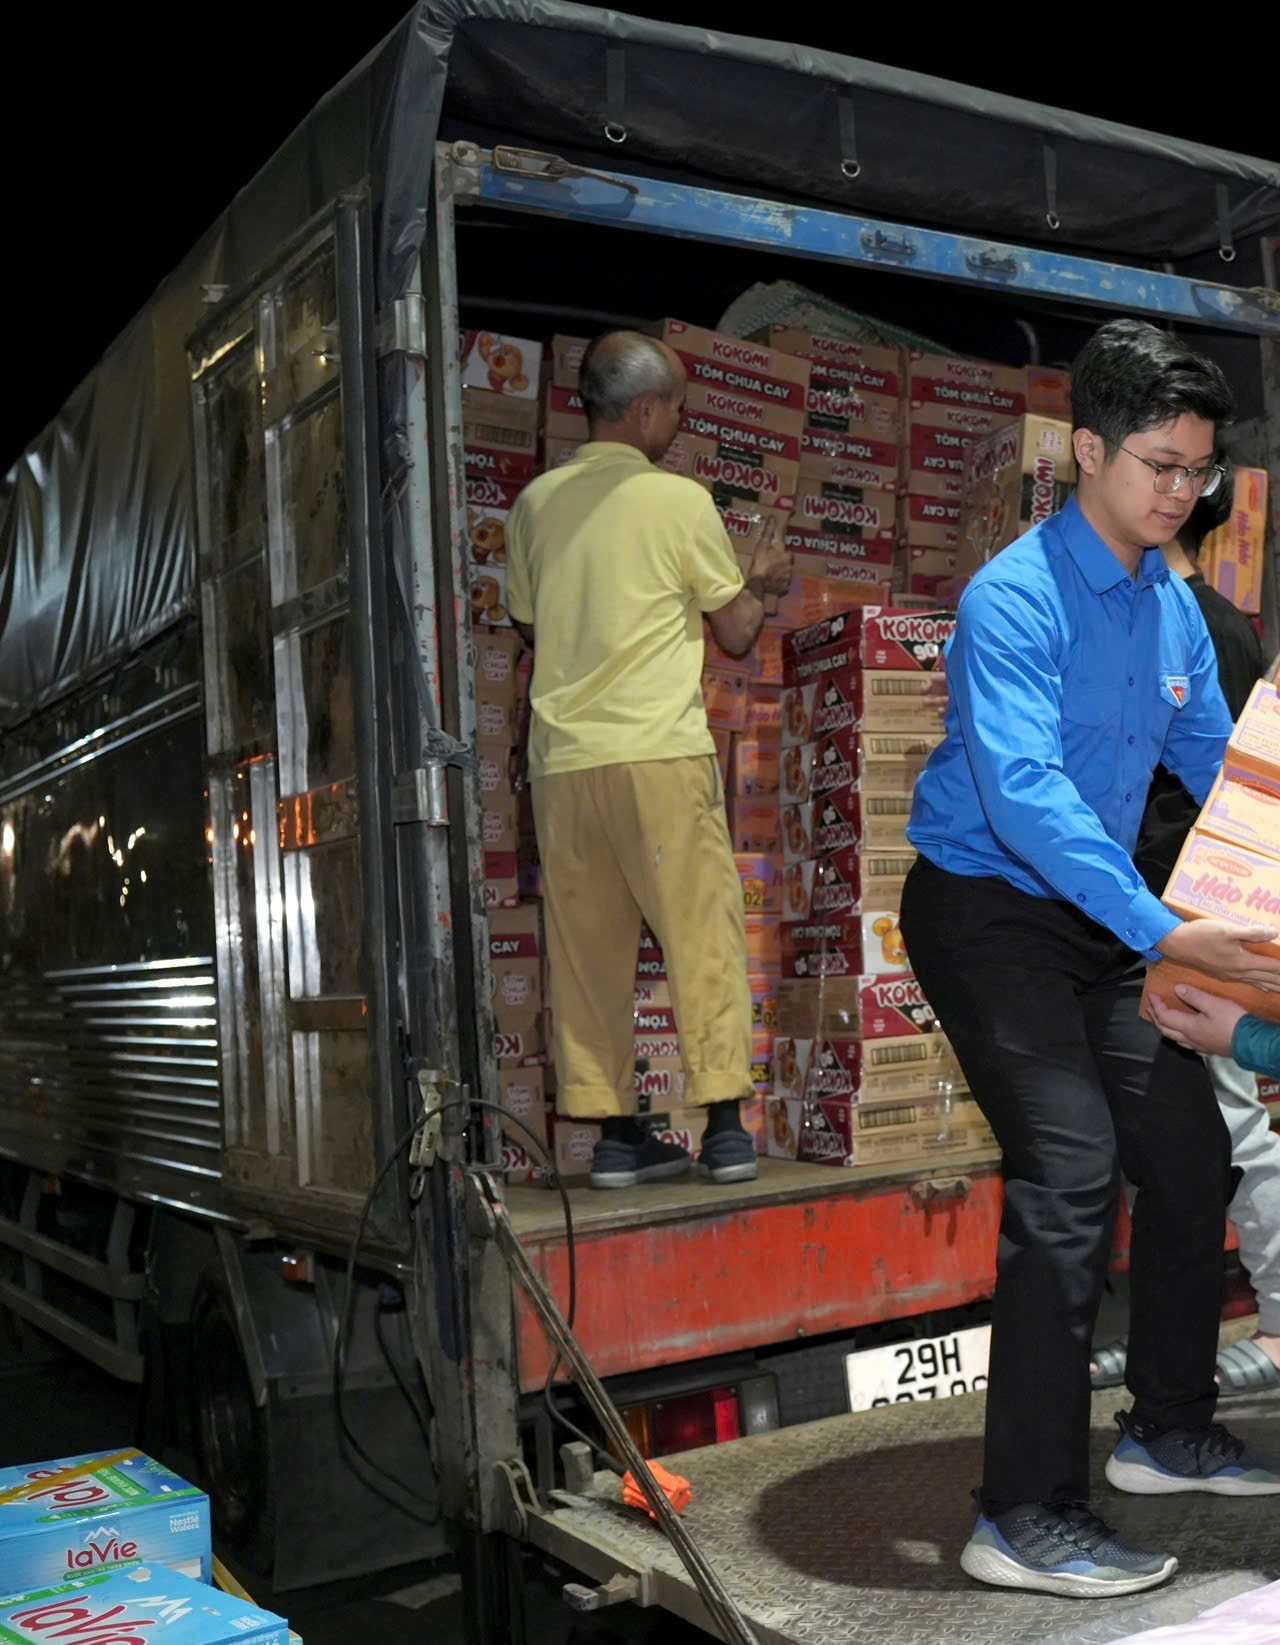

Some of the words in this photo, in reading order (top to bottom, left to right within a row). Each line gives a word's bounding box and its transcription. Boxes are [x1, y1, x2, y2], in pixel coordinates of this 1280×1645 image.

[712, 341, 769, 367] KOKOMI
[694, 363, 723, 381] TÔM
[725, 371, 761, 391] CHUA
[763, 383, 790, 399] CAY
[862, 375, 886, 388] CAY
[705, 392, 763, 419] KOKOMI
[806, 389, 865, 419] OKOMI
[934, 386, 960, 399] TÔM
[991, 395, 1015, 408] CAY
[688, 417, 718, 436] TÔM
[720, 427, 757, 446] CHUA
[759, 437, 785, 452] CAY
[935, 433, 960, 447] TÔM
[695, 454, 779, 494] KOKOMI
[1033, 456, 1055, 524] OKOMI
[804, 496, 880, 528] KOKOMI
[803, 537, 839, 553] CHUA
[840, 543, 867, 557] TÔM
[881, 616, 956, 642] KOKOM
[913, 644, 940, 660] 90
[1191, 872, 1243, 904] Hảo
[491, 940, 521, 953] CAY
[637, 1015, 669, 1030] TÔM
[894, 1337, 961, 1385] 29H
[169, 1514, 200, 1528] Nestlé
[67, 1537, 138, 1569] laVie
